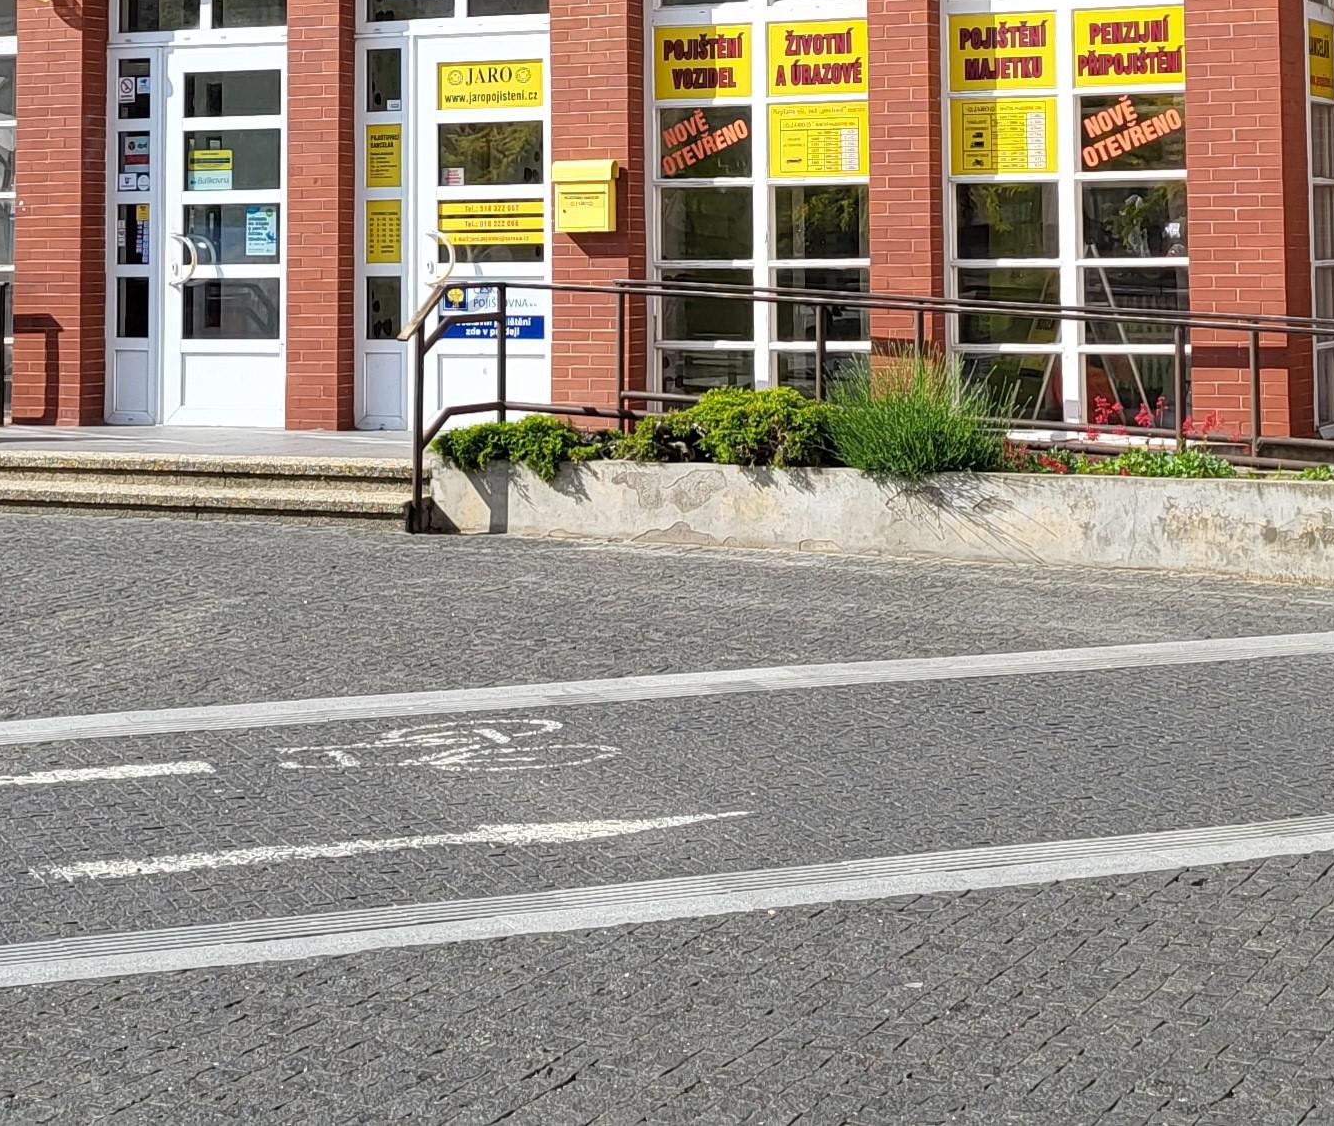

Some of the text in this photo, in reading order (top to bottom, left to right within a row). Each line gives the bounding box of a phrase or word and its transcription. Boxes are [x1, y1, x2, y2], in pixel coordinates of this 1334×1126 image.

[785, 27, 855, 56] ŽIVOTNÍ
[959, 20, 1049, 50] POJIŠTĚNÍ
[1089, 14, 1170, 45] PENZIJNÍ
[663, 31, 745, 61] POJIŠTĚNÍ
[1078, 45, 1185, 77] PŘIPOJIŠTĚNÍ
[466, 66, 513, 86] JARO
[672, 67, 736, 90] VOZIDEL
[775, 57, 862, 86] A ÚRAZOVÉ
[964, 56, 1043, 80] MAJETKU
[662, 108, 709, 148] NOVĚ
[1083, 94, 1138, 138] NOVĚ
[662, 119, 748, 175] OTEVŘENO
[1082, 108, 1182, 167] OTEVŘENO
[465, 327, 481, 336] zde
